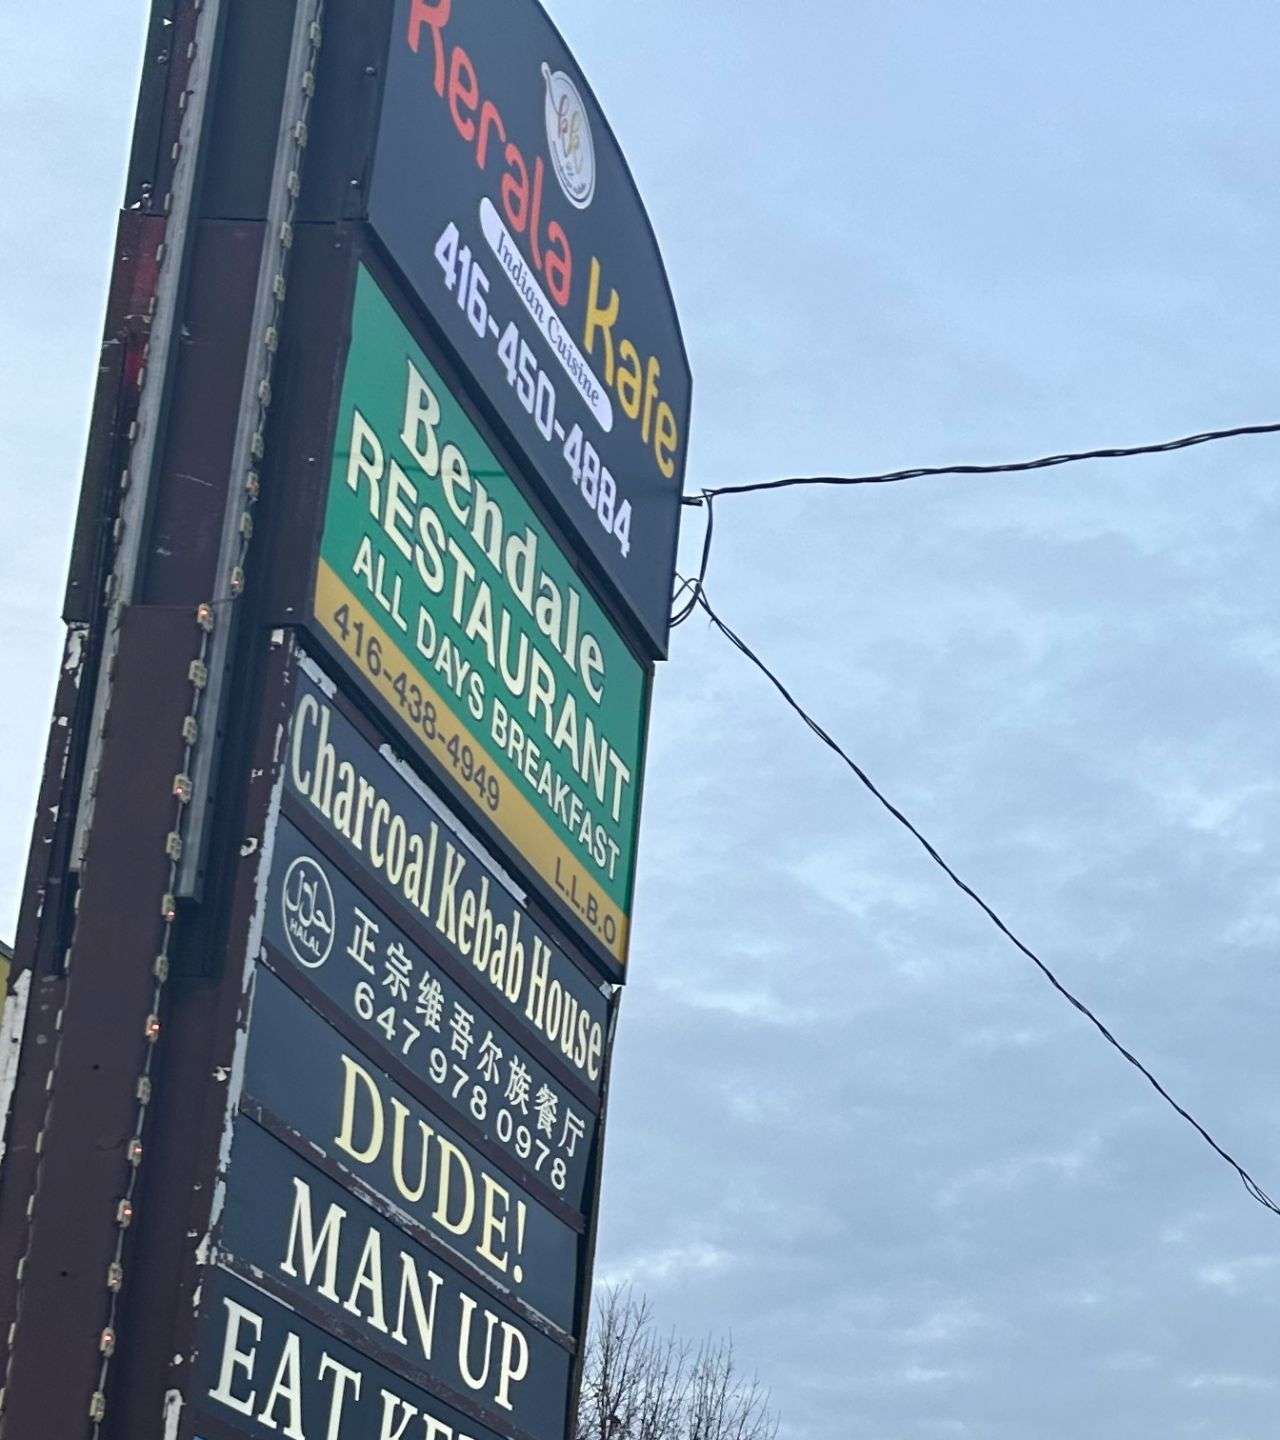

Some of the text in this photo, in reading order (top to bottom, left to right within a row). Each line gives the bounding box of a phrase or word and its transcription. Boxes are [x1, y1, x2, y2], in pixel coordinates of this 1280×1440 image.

[434, 221, 633, 559] 416-450-4884
[496, 231, 600, 407] Indian Cuisine
[584, 256, 677, 478] Kafe
[347, 408, 631, 824] RESTAURANT
[400, 359, 605, 704] Bendale
[333, 603, 501, 813] 416-438-4949
[352, 535, 621, 882] ALL DAYS BREAKFAST
[290, 918, 321, 957] HALAL
[291, 693, 602, 1082] Charcoal Kebab House
[347, 907, 584, 1158] 正宗维吾尔族餐厅
[354, 980, 567, 1192] 647 978 0978
[334, 1054, 527, 1284] DUDE!
[280, 1177, 530, 1411] MAN UP
